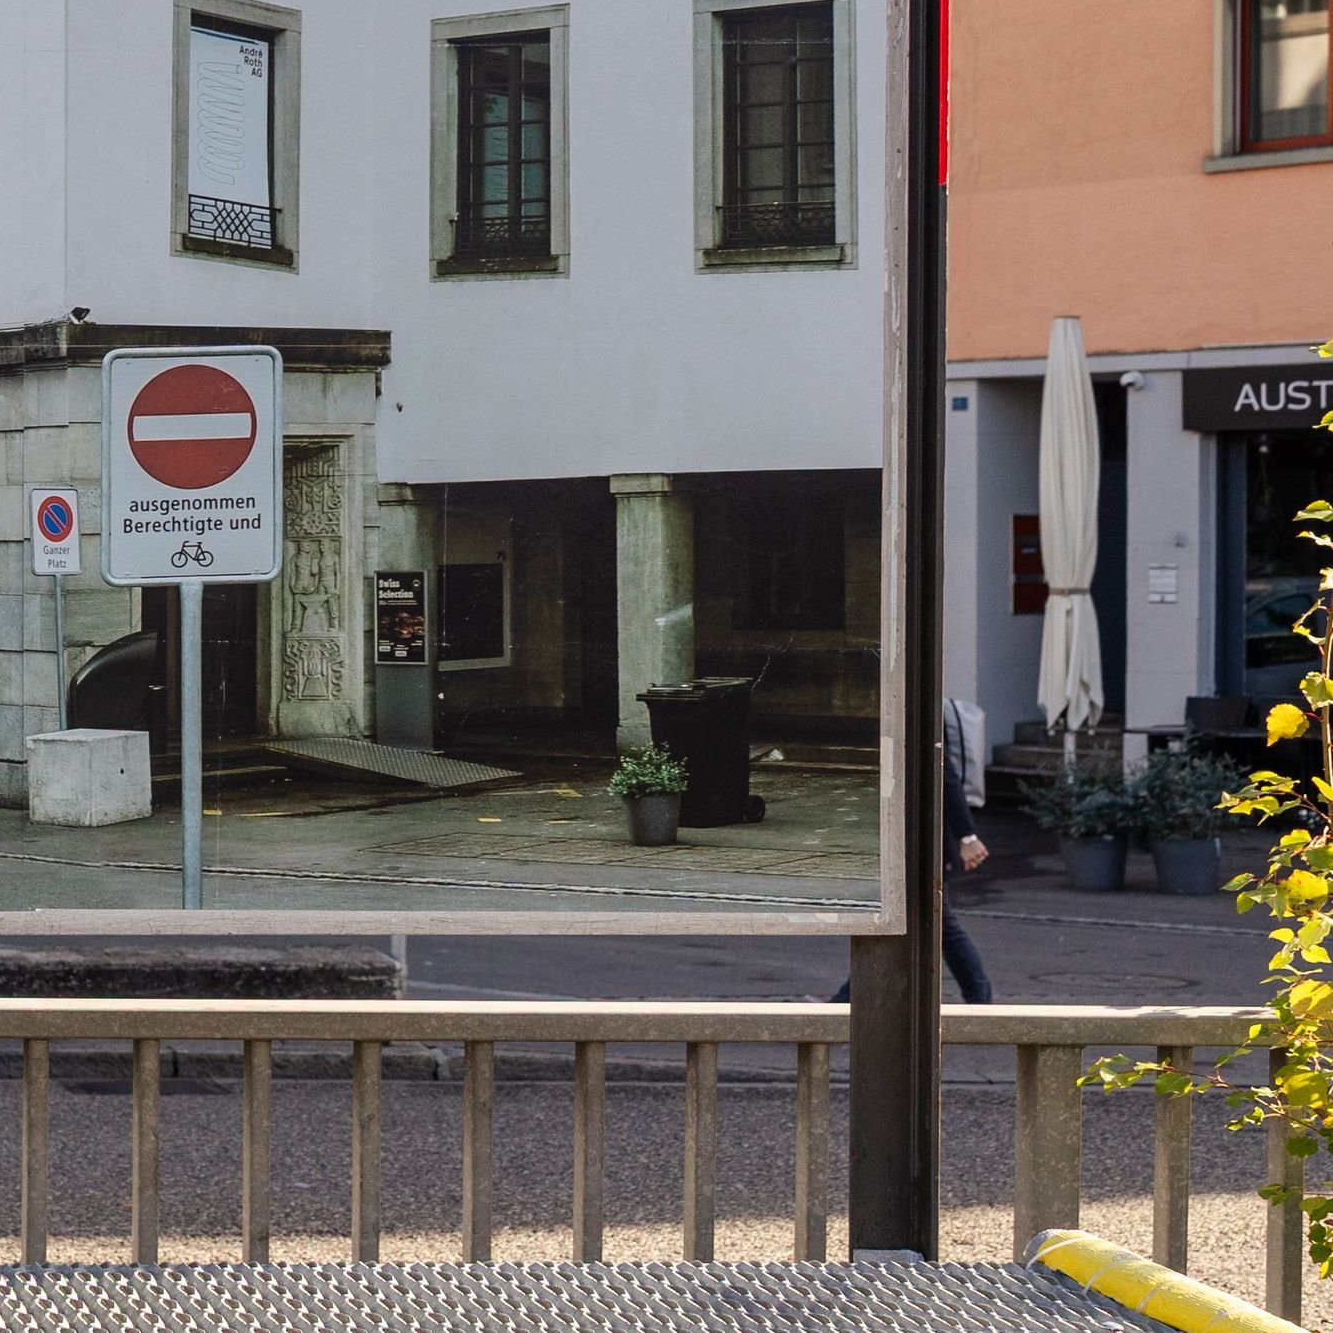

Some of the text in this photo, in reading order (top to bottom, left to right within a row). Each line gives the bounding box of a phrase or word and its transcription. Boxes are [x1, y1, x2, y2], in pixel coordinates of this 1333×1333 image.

[239, 45, 263, 58] André
[244, 56, 263, 68] Roth
[251, 67, 263, 78] AG
[1234, 380, 1333, 412] AUST
[129, 497, 256, 515] ausgenommen
[123, 514, 261, 535] Berechtigte und
[43, 545, 70, 555] Ganzer
[47, 559, 67, 568] Platz
[378, 578, 400, 588] Swiss
[378, 589, 414, 599] Selection
